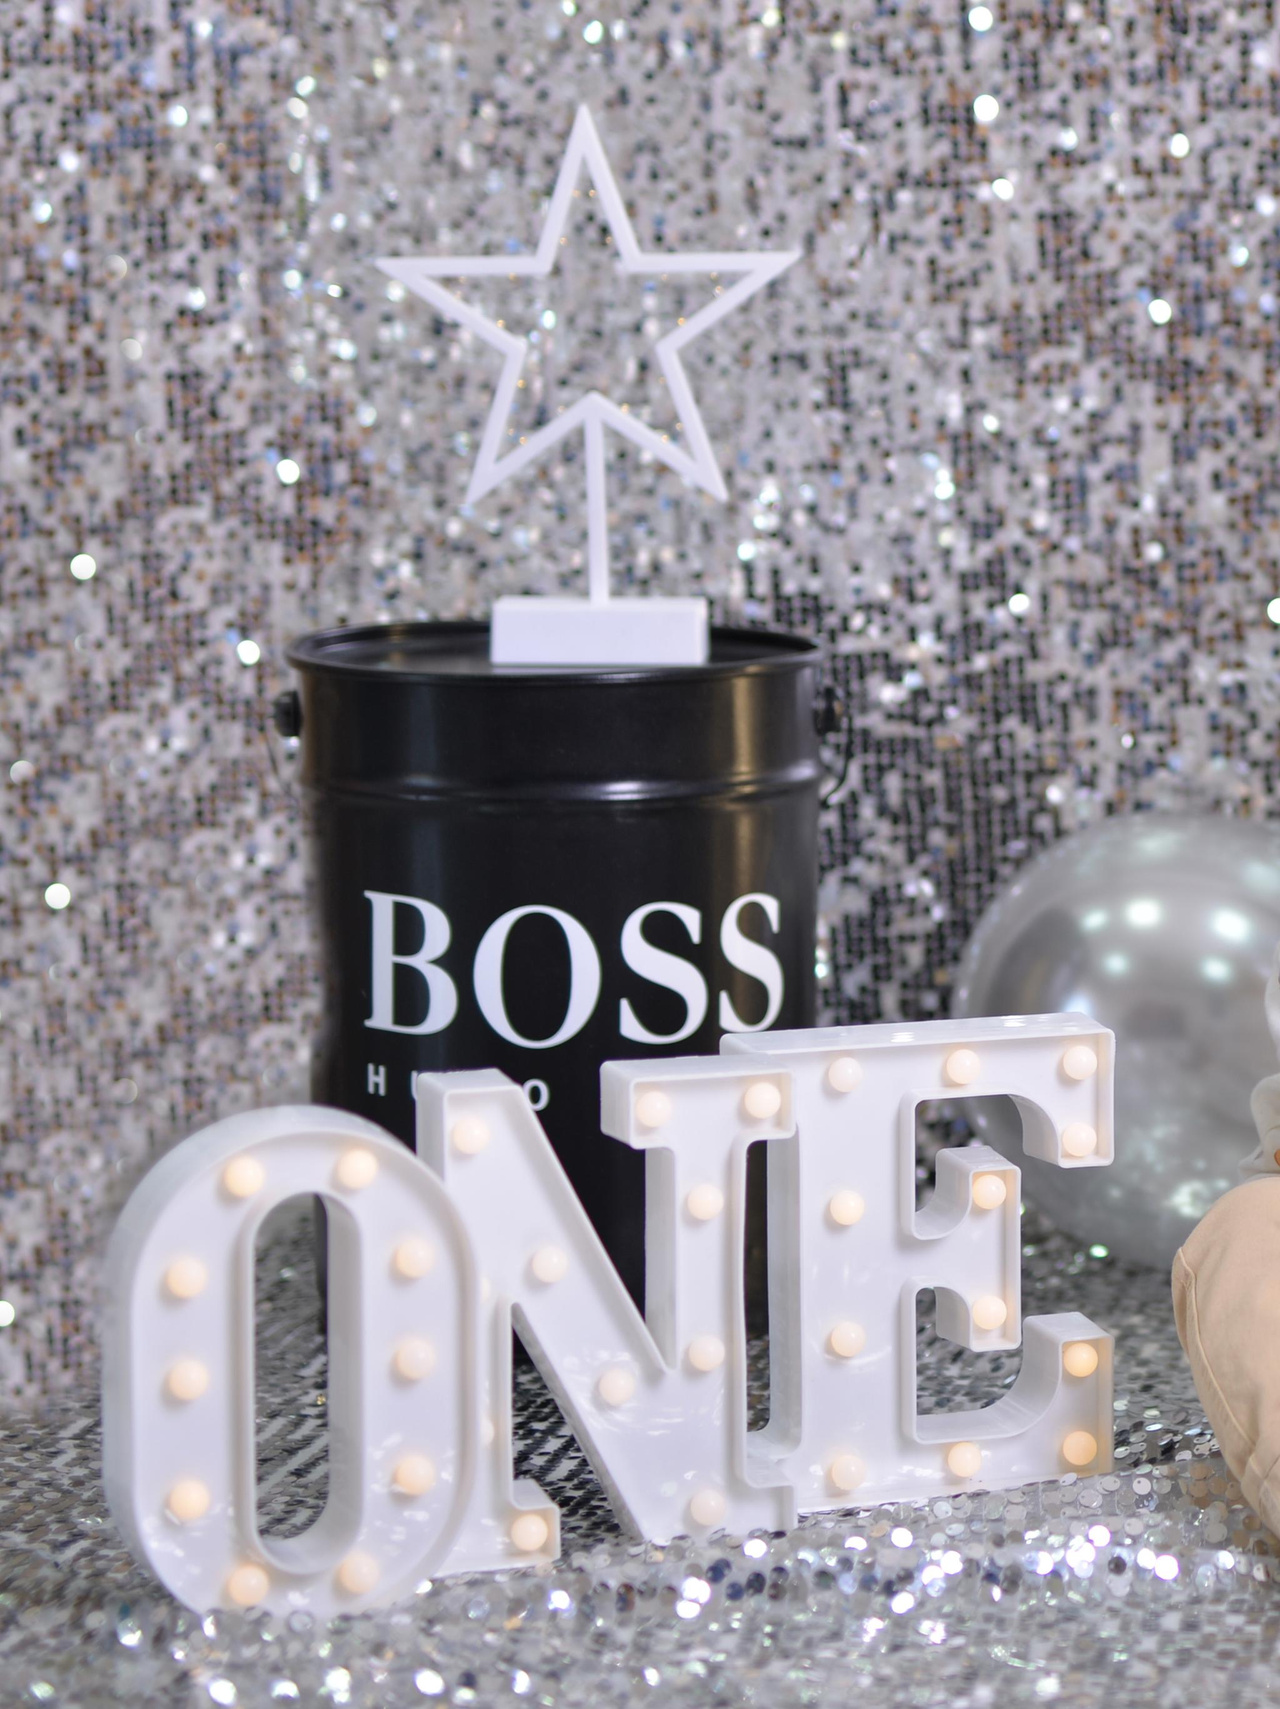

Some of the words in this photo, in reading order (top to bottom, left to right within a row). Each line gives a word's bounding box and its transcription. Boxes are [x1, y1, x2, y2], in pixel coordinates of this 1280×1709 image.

[364, 889, 785, 1050] BOSS
[366, 1062, 551, 1111] HO
[102, 1013, 1116, 1616] ONE
